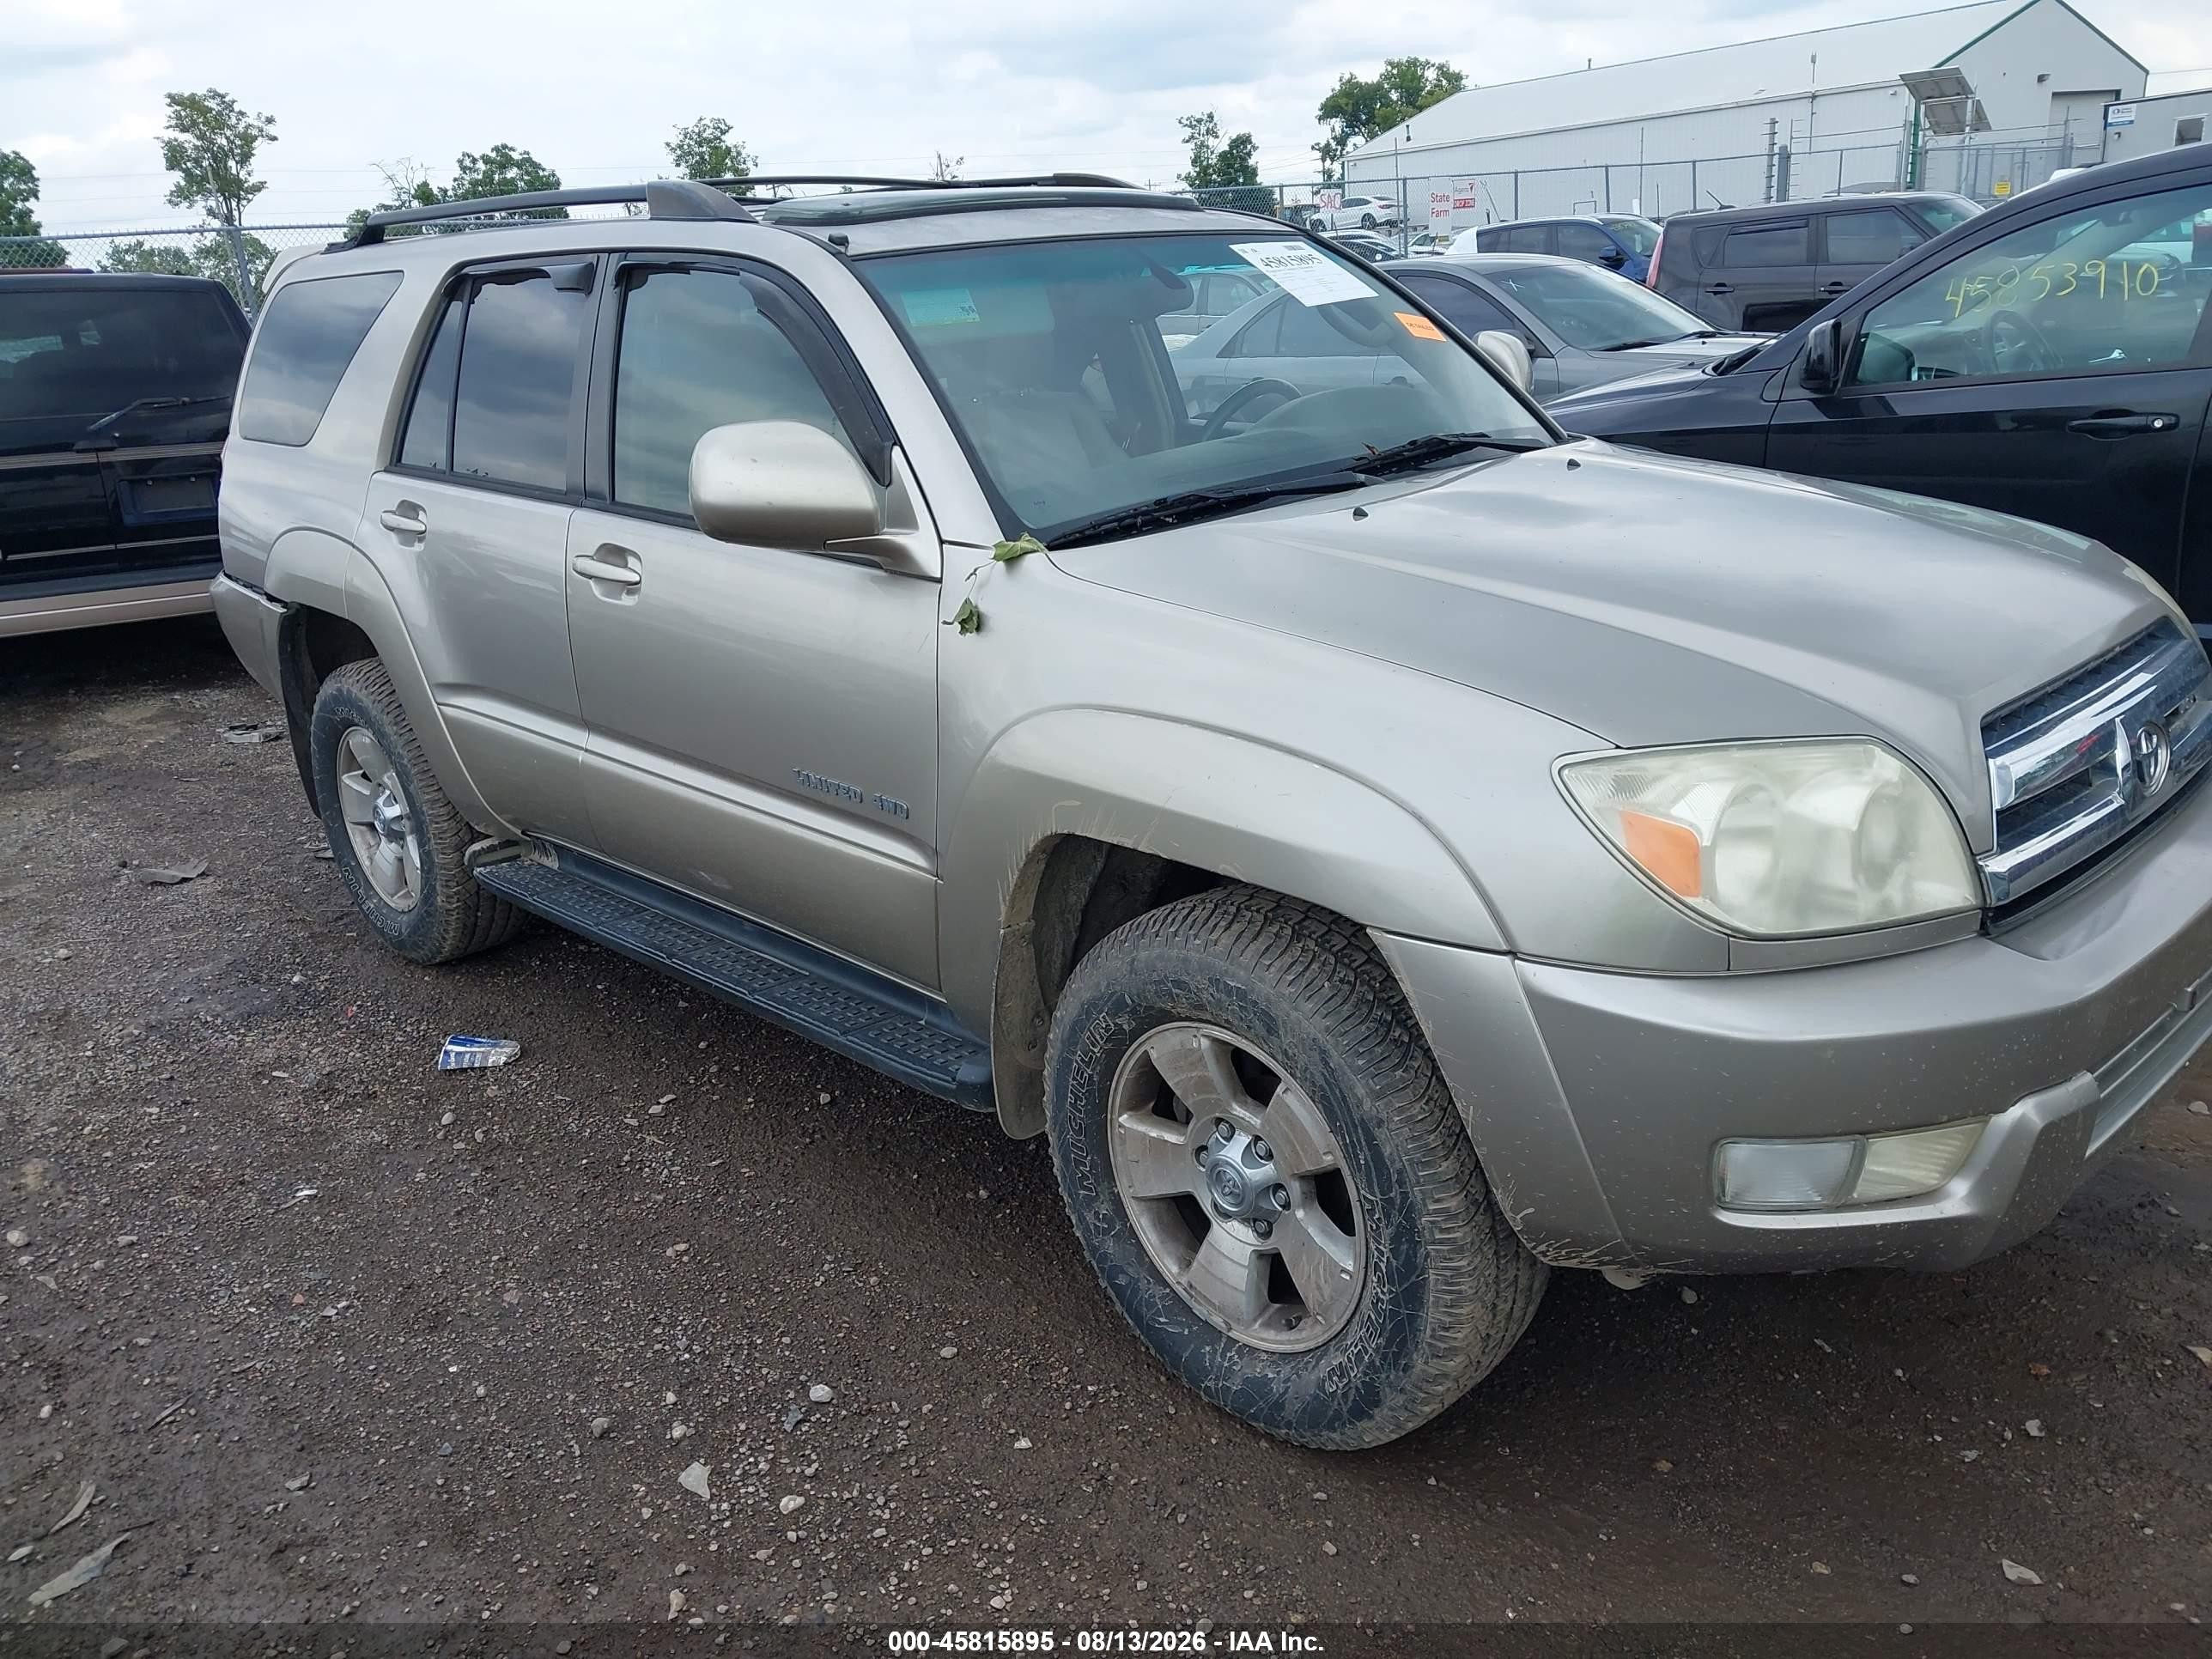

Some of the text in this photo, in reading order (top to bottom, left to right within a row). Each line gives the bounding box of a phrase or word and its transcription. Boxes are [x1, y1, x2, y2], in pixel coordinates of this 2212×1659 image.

[1431, 191, 1450, 203] State
[1431, 208, 1449, 218] Farm
[1260, 253, 1322, 268] 45815895
[1946, 259, 2159, 319] 45853910
[343, 866, 400, 936] MICHELIN
[1066, 1012, 1115, 1196] MICHELIN
[1325, 1190, 1389, 1393] MICHELIN
